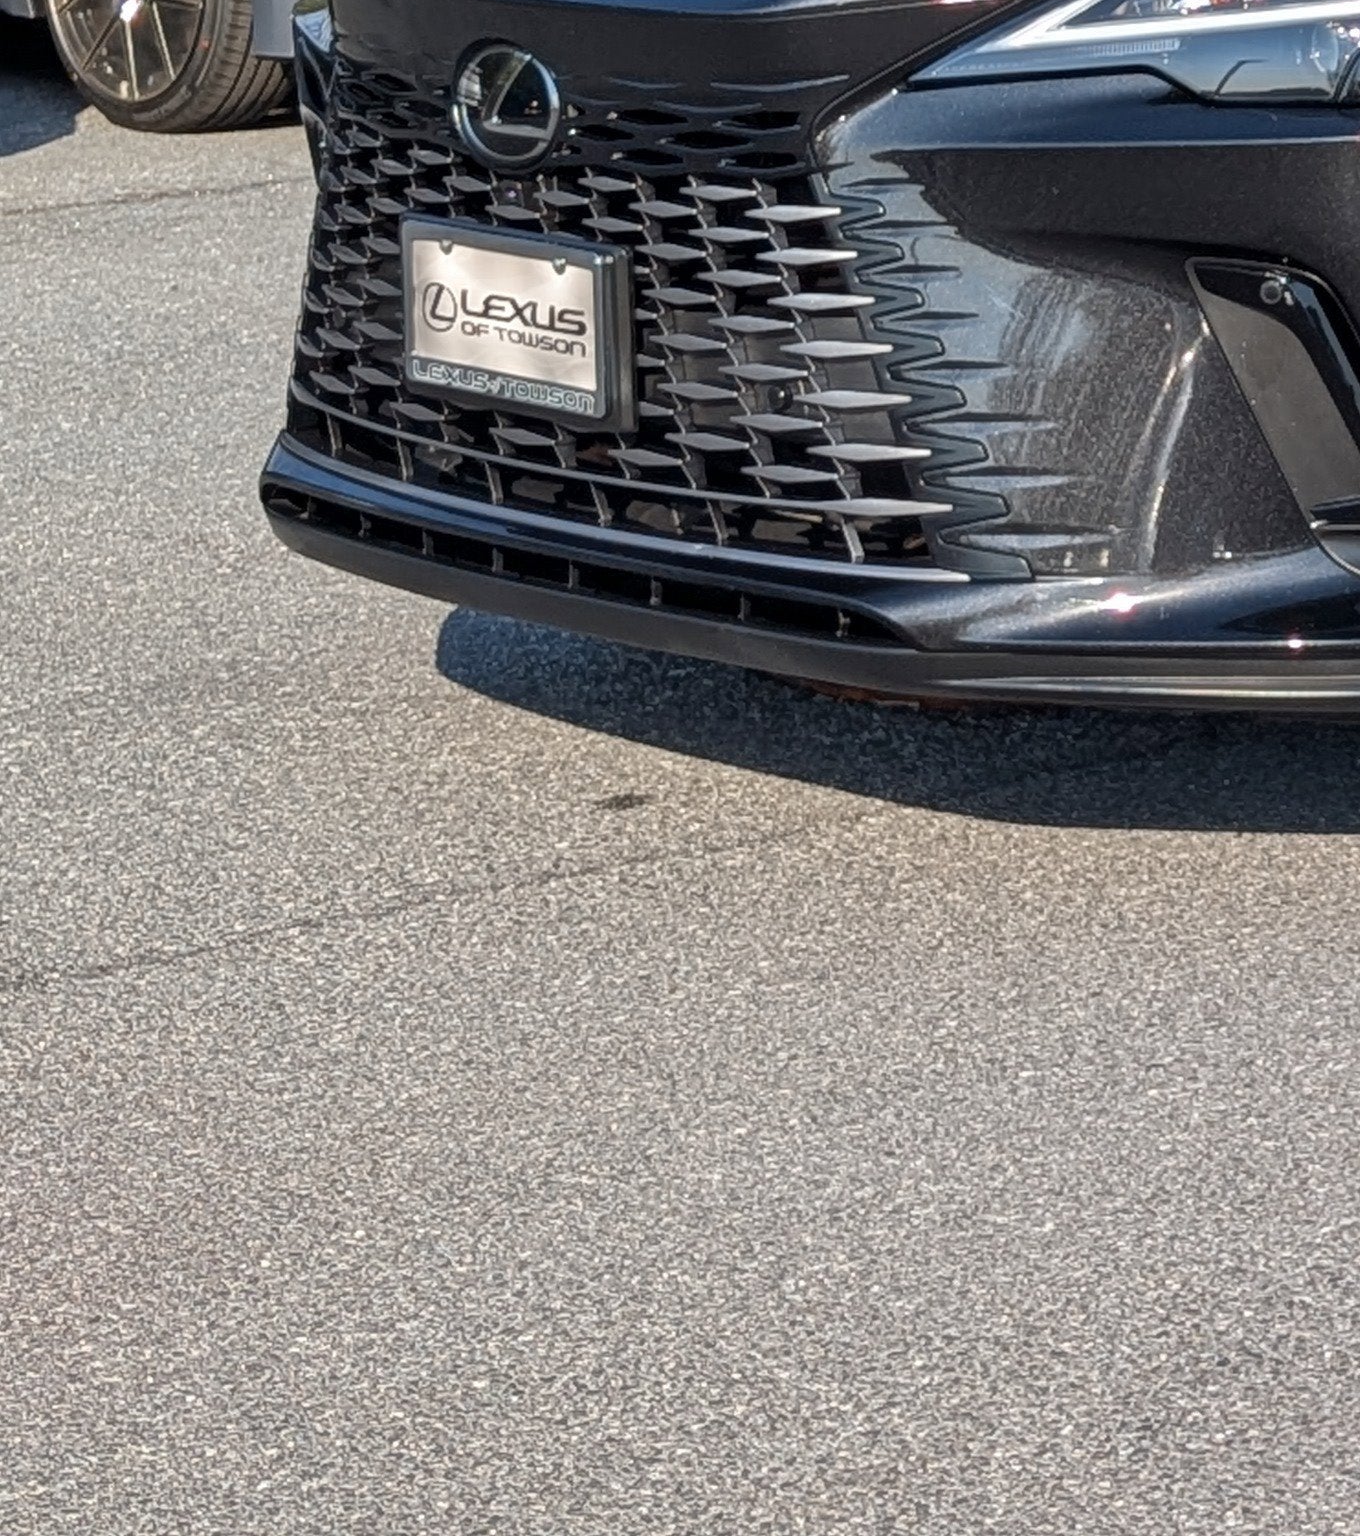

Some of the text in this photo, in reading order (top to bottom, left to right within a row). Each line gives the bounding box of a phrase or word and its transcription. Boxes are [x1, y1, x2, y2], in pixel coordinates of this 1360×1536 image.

[460, 288, 588, 336] LEXUS
[460, 320, 587, 358] OF TOWSON
[412, 359, 489, 392] LEXUS
[501, 378, 595, 414] TOWSON
